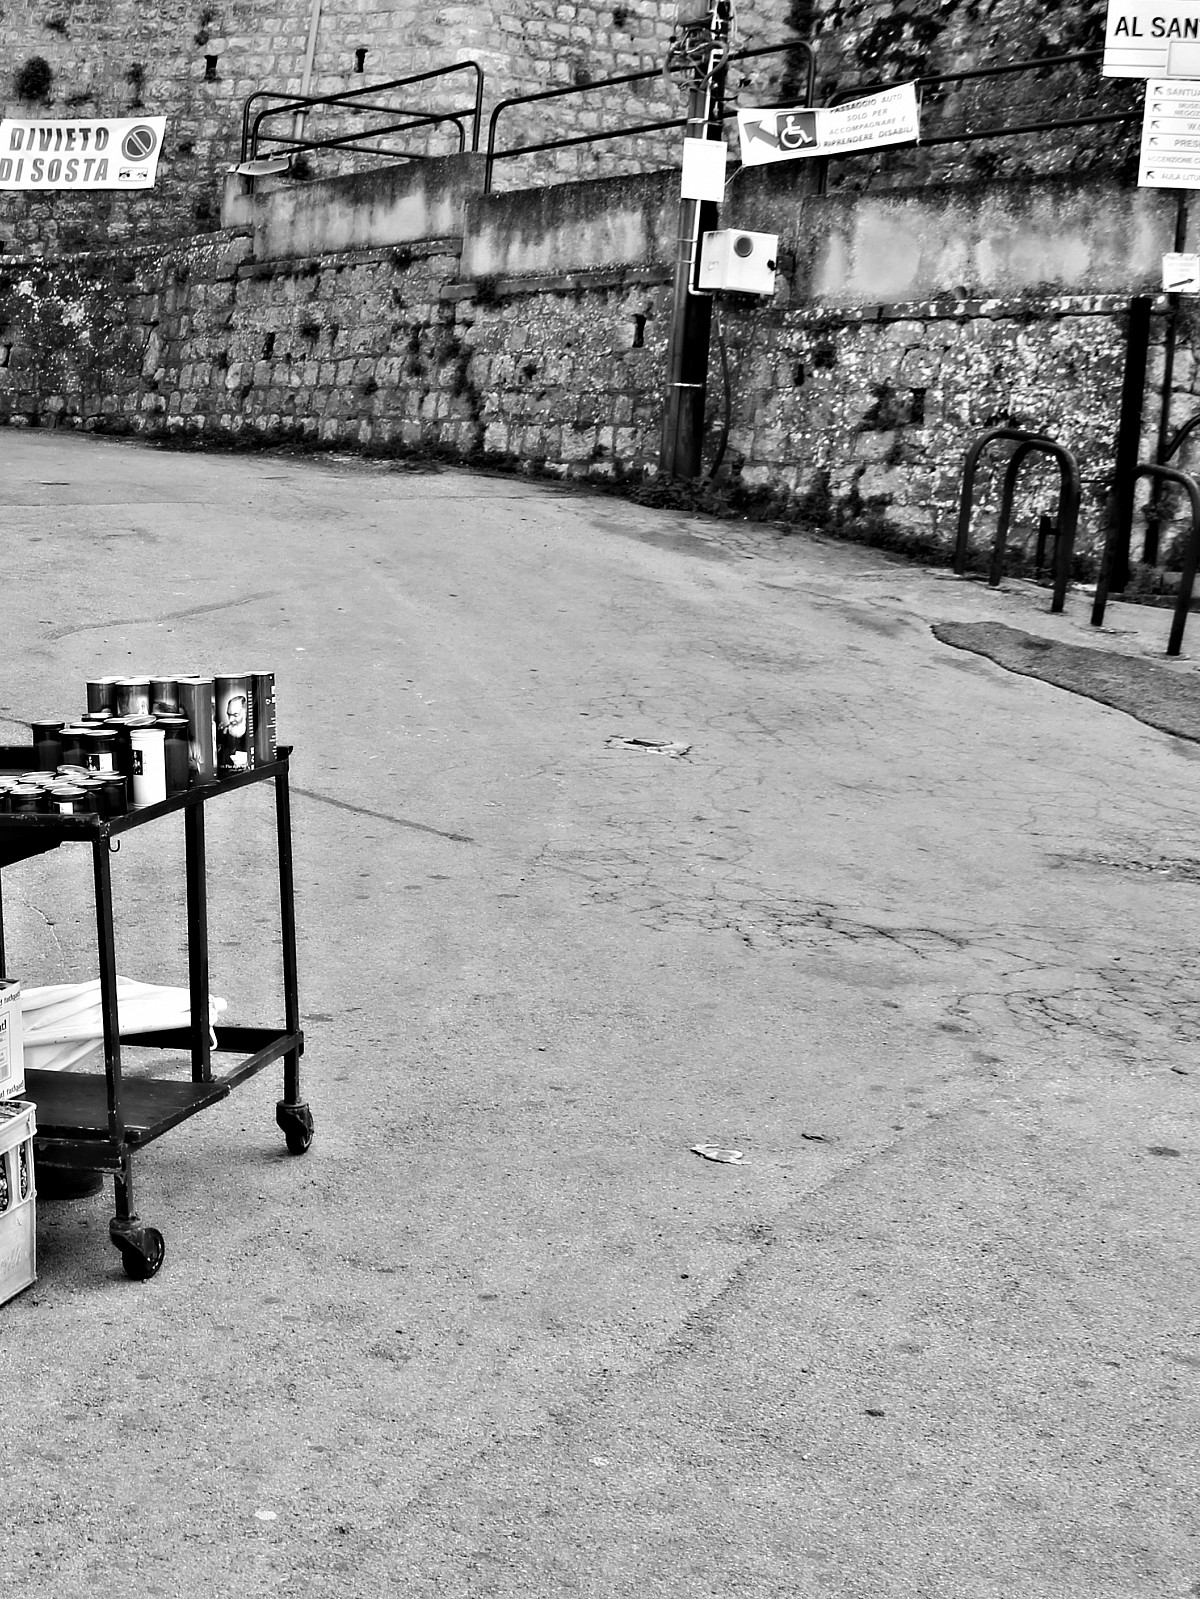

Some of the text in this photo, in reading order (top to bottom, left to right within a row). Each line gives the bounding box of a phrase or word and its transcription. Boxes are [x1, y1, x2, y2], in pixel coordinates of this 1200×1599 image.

[1113, 15, 1200, 39] AL SAN
[880, 93, 902, 104] AUTO
[1177, 102, 1200, 110] MUSE
[846, 108, 888, 122] SOLO PER
[829, 117, 897, 136] ACCOMPAGNARE
[9, 126, 110, 152] DIVIETO
[823, 126, 914, 148] RIPRENDERE DISABILI
[1174, 138, 1200, 148] PRES
[29, 158, 110, 183] SOSTA
[1182, 173, 1200, 181] LITU
